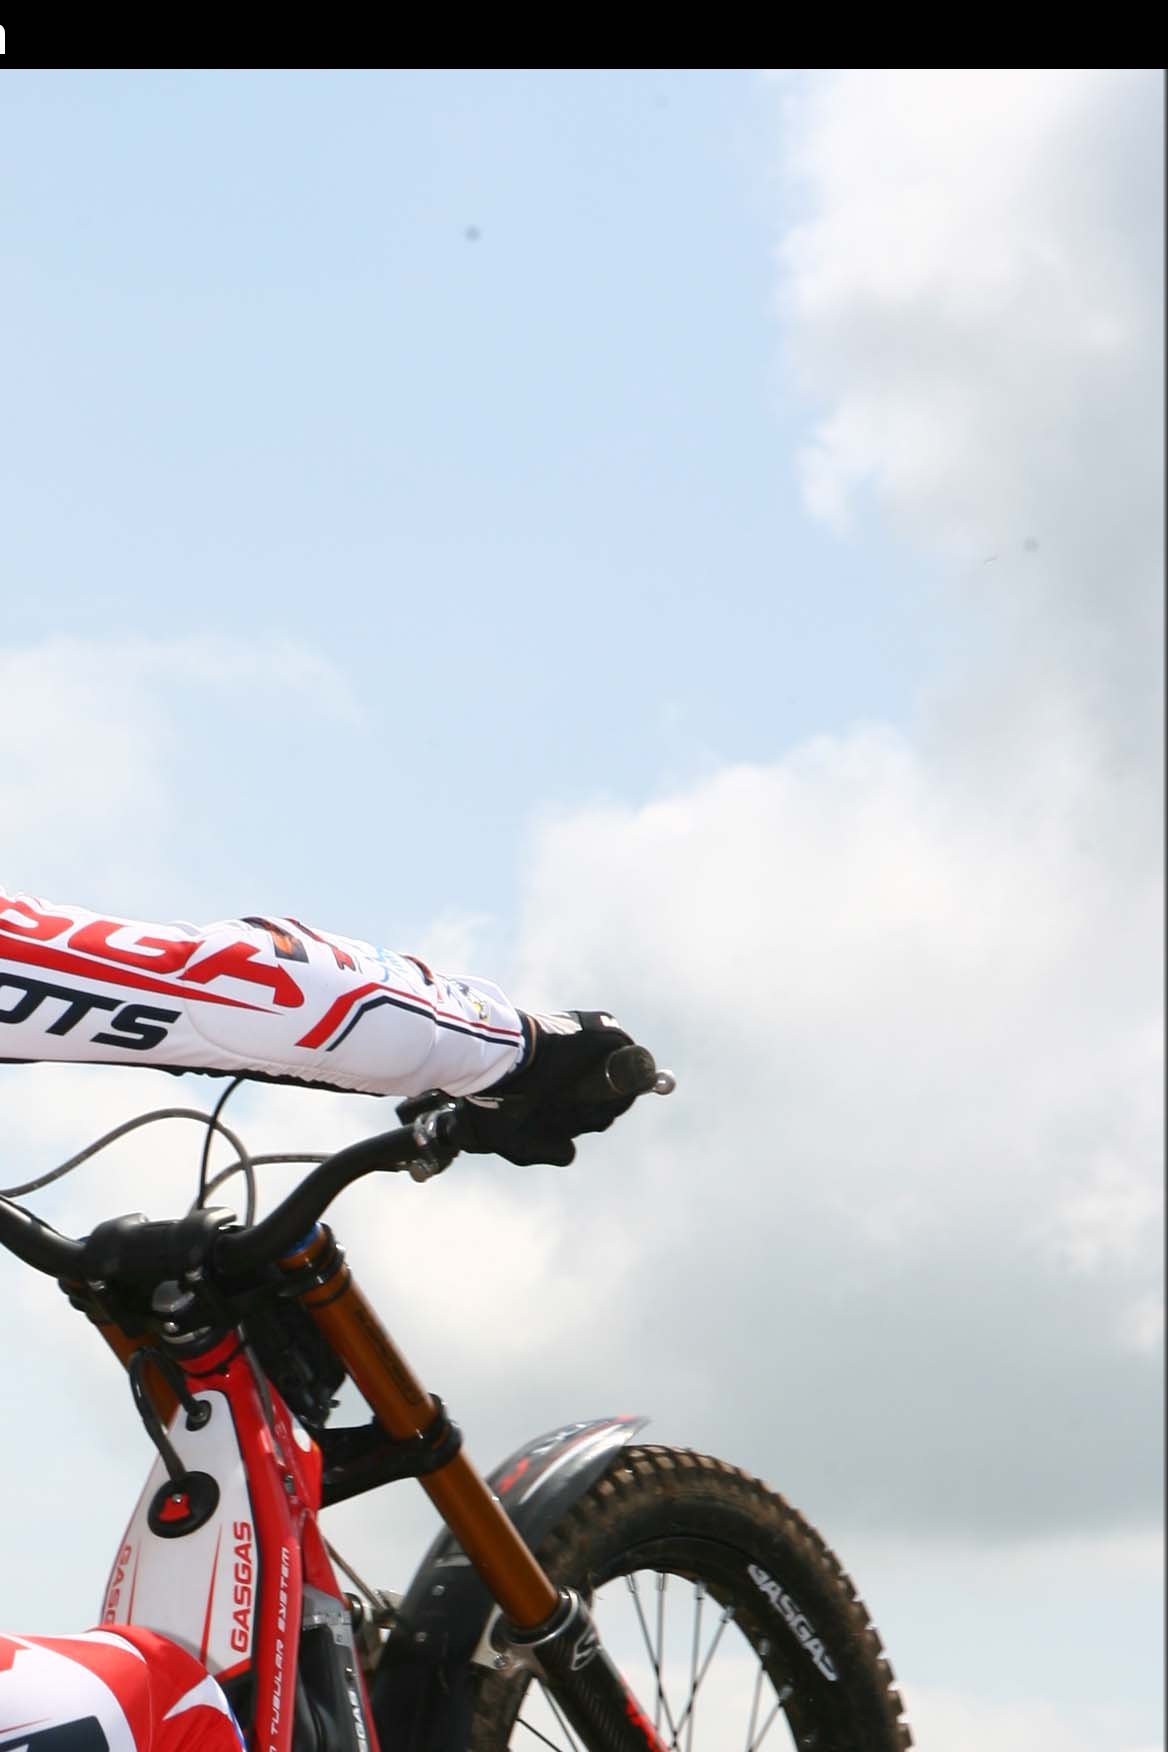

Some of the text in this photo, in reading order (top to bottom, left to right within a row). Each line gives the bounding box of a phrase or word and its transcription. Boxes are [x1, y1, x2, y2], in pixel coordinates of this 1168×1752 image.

[231, 1520, 254, 1653] GASGAS
[270, 1639, 284, 1735] TUBULAR
[277, 1546, 291, 1632] SYSTEM
[746, 1563, 838, 1681] GASGAS
